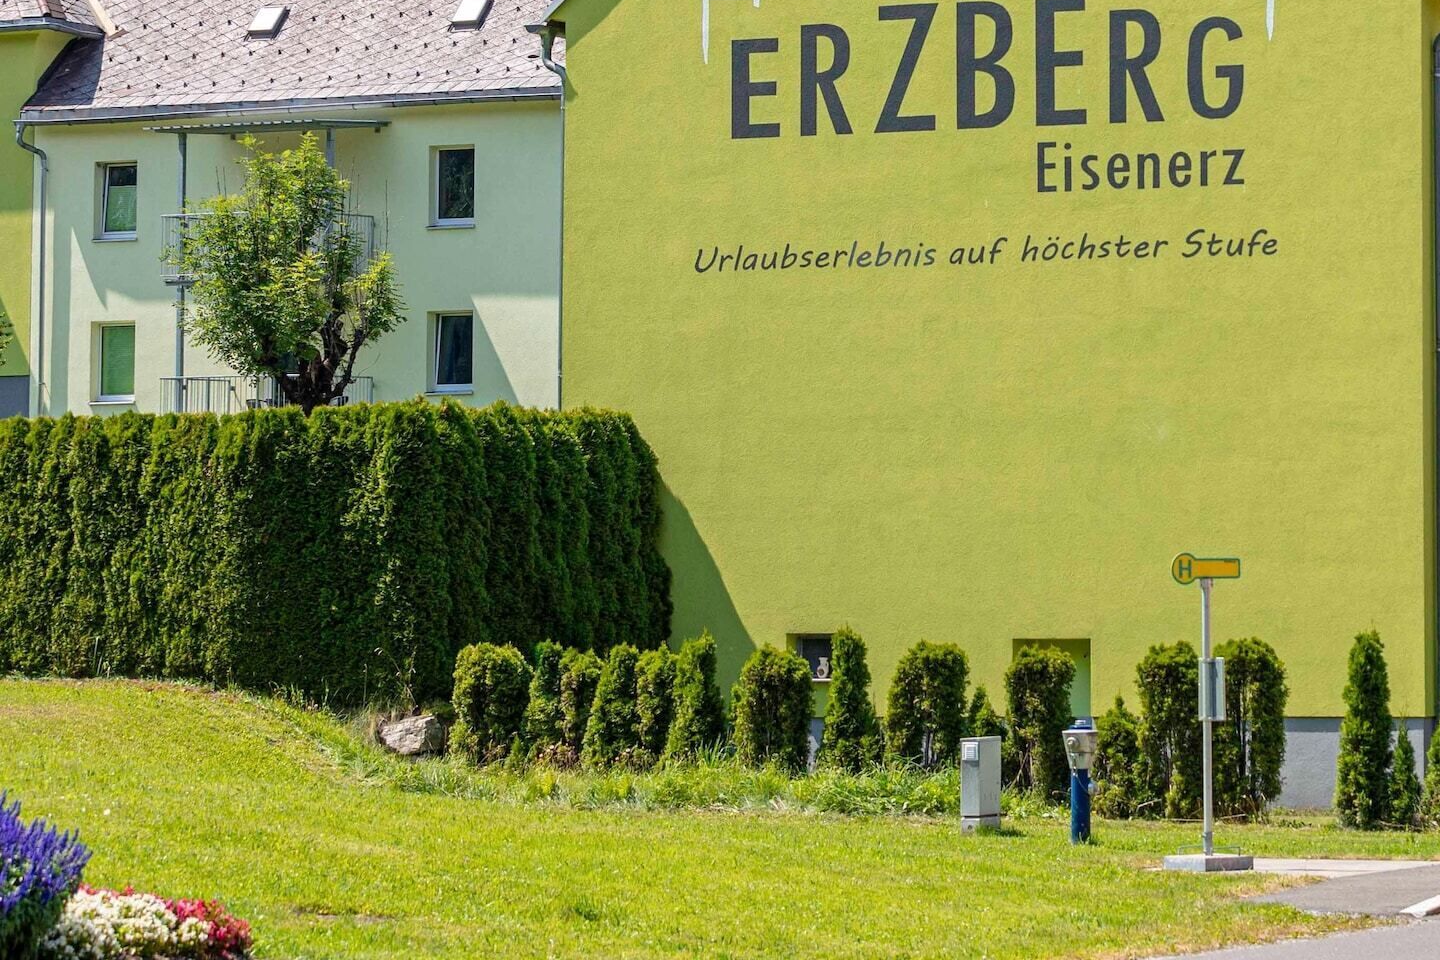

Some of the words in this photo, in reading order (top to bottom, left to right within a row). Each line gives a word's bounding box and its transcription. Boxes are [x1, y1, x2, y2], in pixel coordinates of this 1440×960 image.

[1036, 141, 1246, 193] Eisenerz
[694, 240, 937, 274] Urlaubserlebnis
[949, 236, 1009, 265] auf
[1021, 232, 1169, 262] höchster
[1182, 228, 1278, 258] Stufe
[1178, 559, 1193, 578] H
